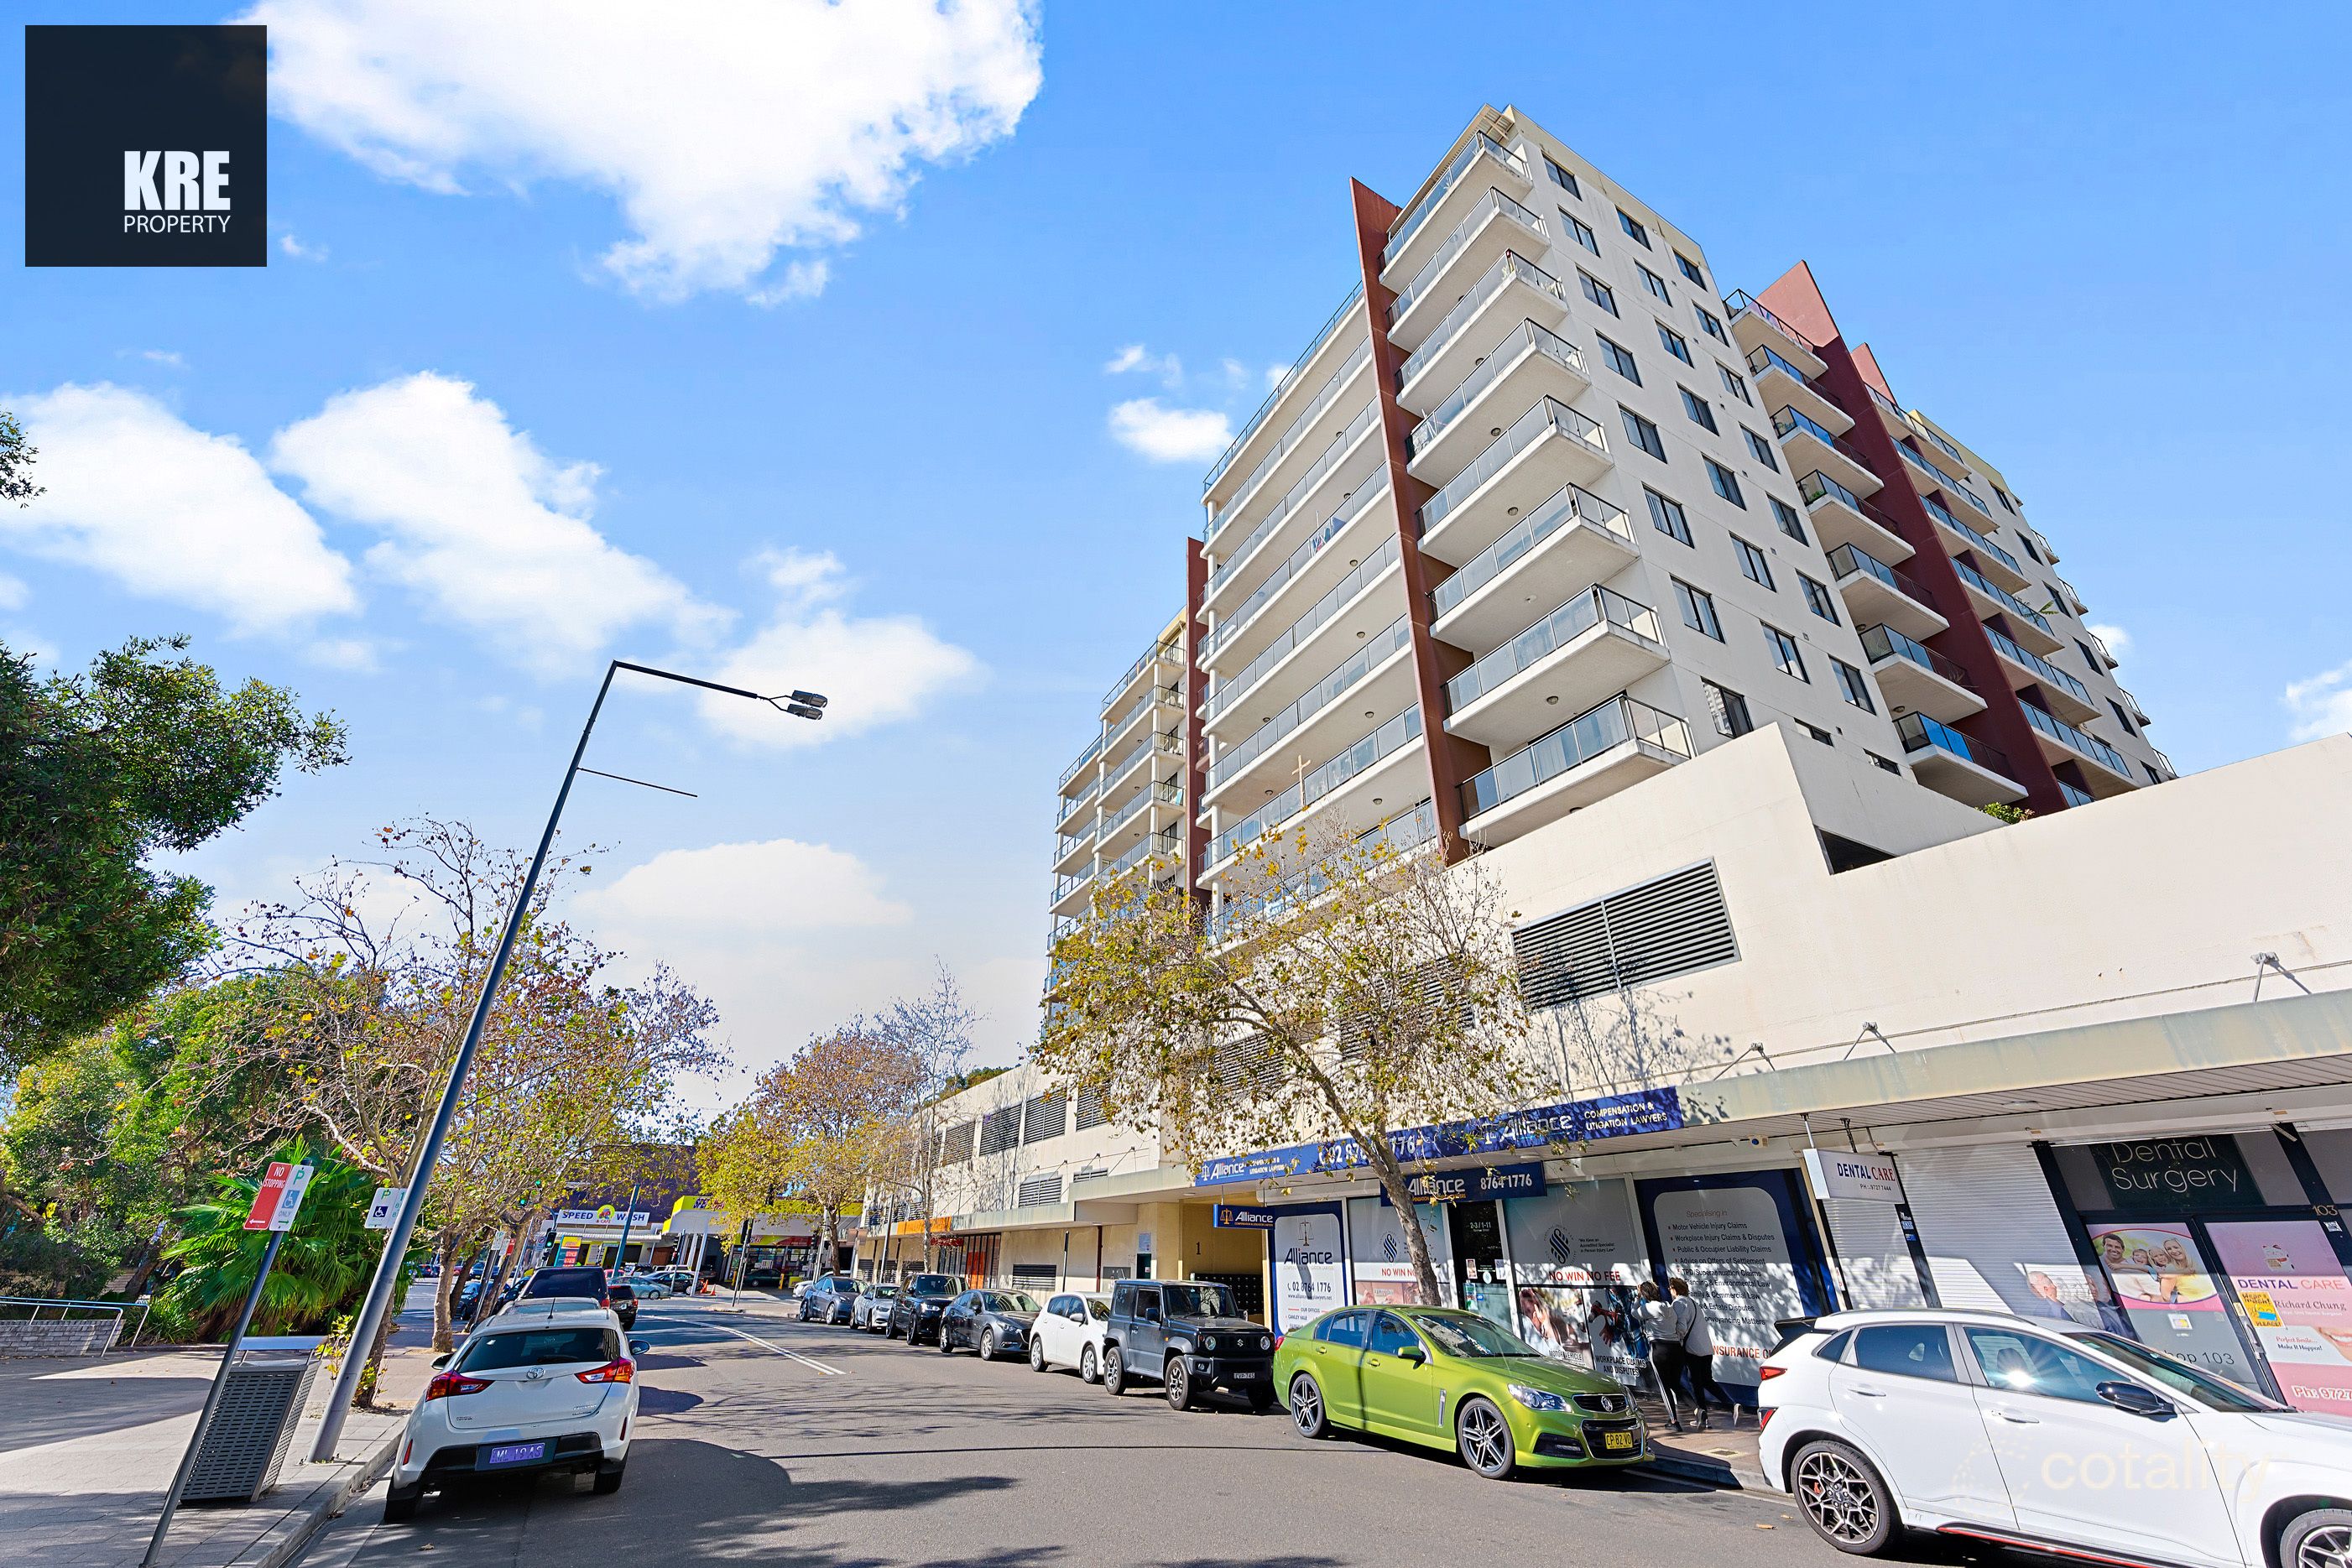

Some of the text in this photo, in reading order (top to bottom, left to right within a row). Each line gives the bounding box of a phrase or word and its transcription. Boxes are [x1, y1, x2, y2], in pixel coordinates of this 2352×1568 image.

[1499, 1102, 1654, 1143] Alliance COMPENSATION &
[1586, 1112, 1667, 1131] LITIGATION LAWYERS
[2110, 1137, 2217, 1163] Dental
[274, 1166, 285, 1177] NO
[1210, 1162, 1244, 1180] Alliance
[1837, 1163, 1896, 1181] DENTAL CARE
[293, 1169, 305, 1185] P
[1480, 1176, 1505, 1190] 8764
[1508, 1174, 1532, 1187] 1776
[2111, 1167, 2236, 1193] Surgery
[263, 1178, 285, 1189] STOPPING
[381, 1190, 391, 1200] P
[1686, 1210, 1720, 1218] Specialising
[2313, 1205, 2338, 1216] 103
[562, 1211, 645, 1222] SPEED WSH
[1235, 1211, 1273, 1223] Alliance
[1710, 1222, 1726, 1231] Injury
[1196, 1242, 1201, 1254] 1
[1700, 1246, 1726, 1254] Occupier
[1727, 1245, 1750, 1253] Liability
[1284, 1248, 1333, 1265] Alliance
[1382, 1268, 1392, 1276] NO
[1393, 1268, 1406, 1277] WIN
[1549, 1271, 1621, 1281] NO WIN NO FEE
[1292, 1282, 1331, 1293] 02 8764 1776
[2237, 1279, 2346, 1290] DENTAL CARE
[1729, 1304, 1755, 1312] Disputes
[2273, 1300, 2347, 1311] Richard Chung
[1705, 1316, 1741, 1325] onveyancing
[1548, 1350, 1583, 1361] MOTOR VEHICLE
[1713, 1346, 1760, 1359] NSURANCE
[1596, 1355, 1625, 1365] WORKPLACE
[1626, 1357, 1647, 1368] CLAIMS
[2202, 1352, 2235, 1365] 103
[1614, 1367, 1640, 1377] DISPUTES
